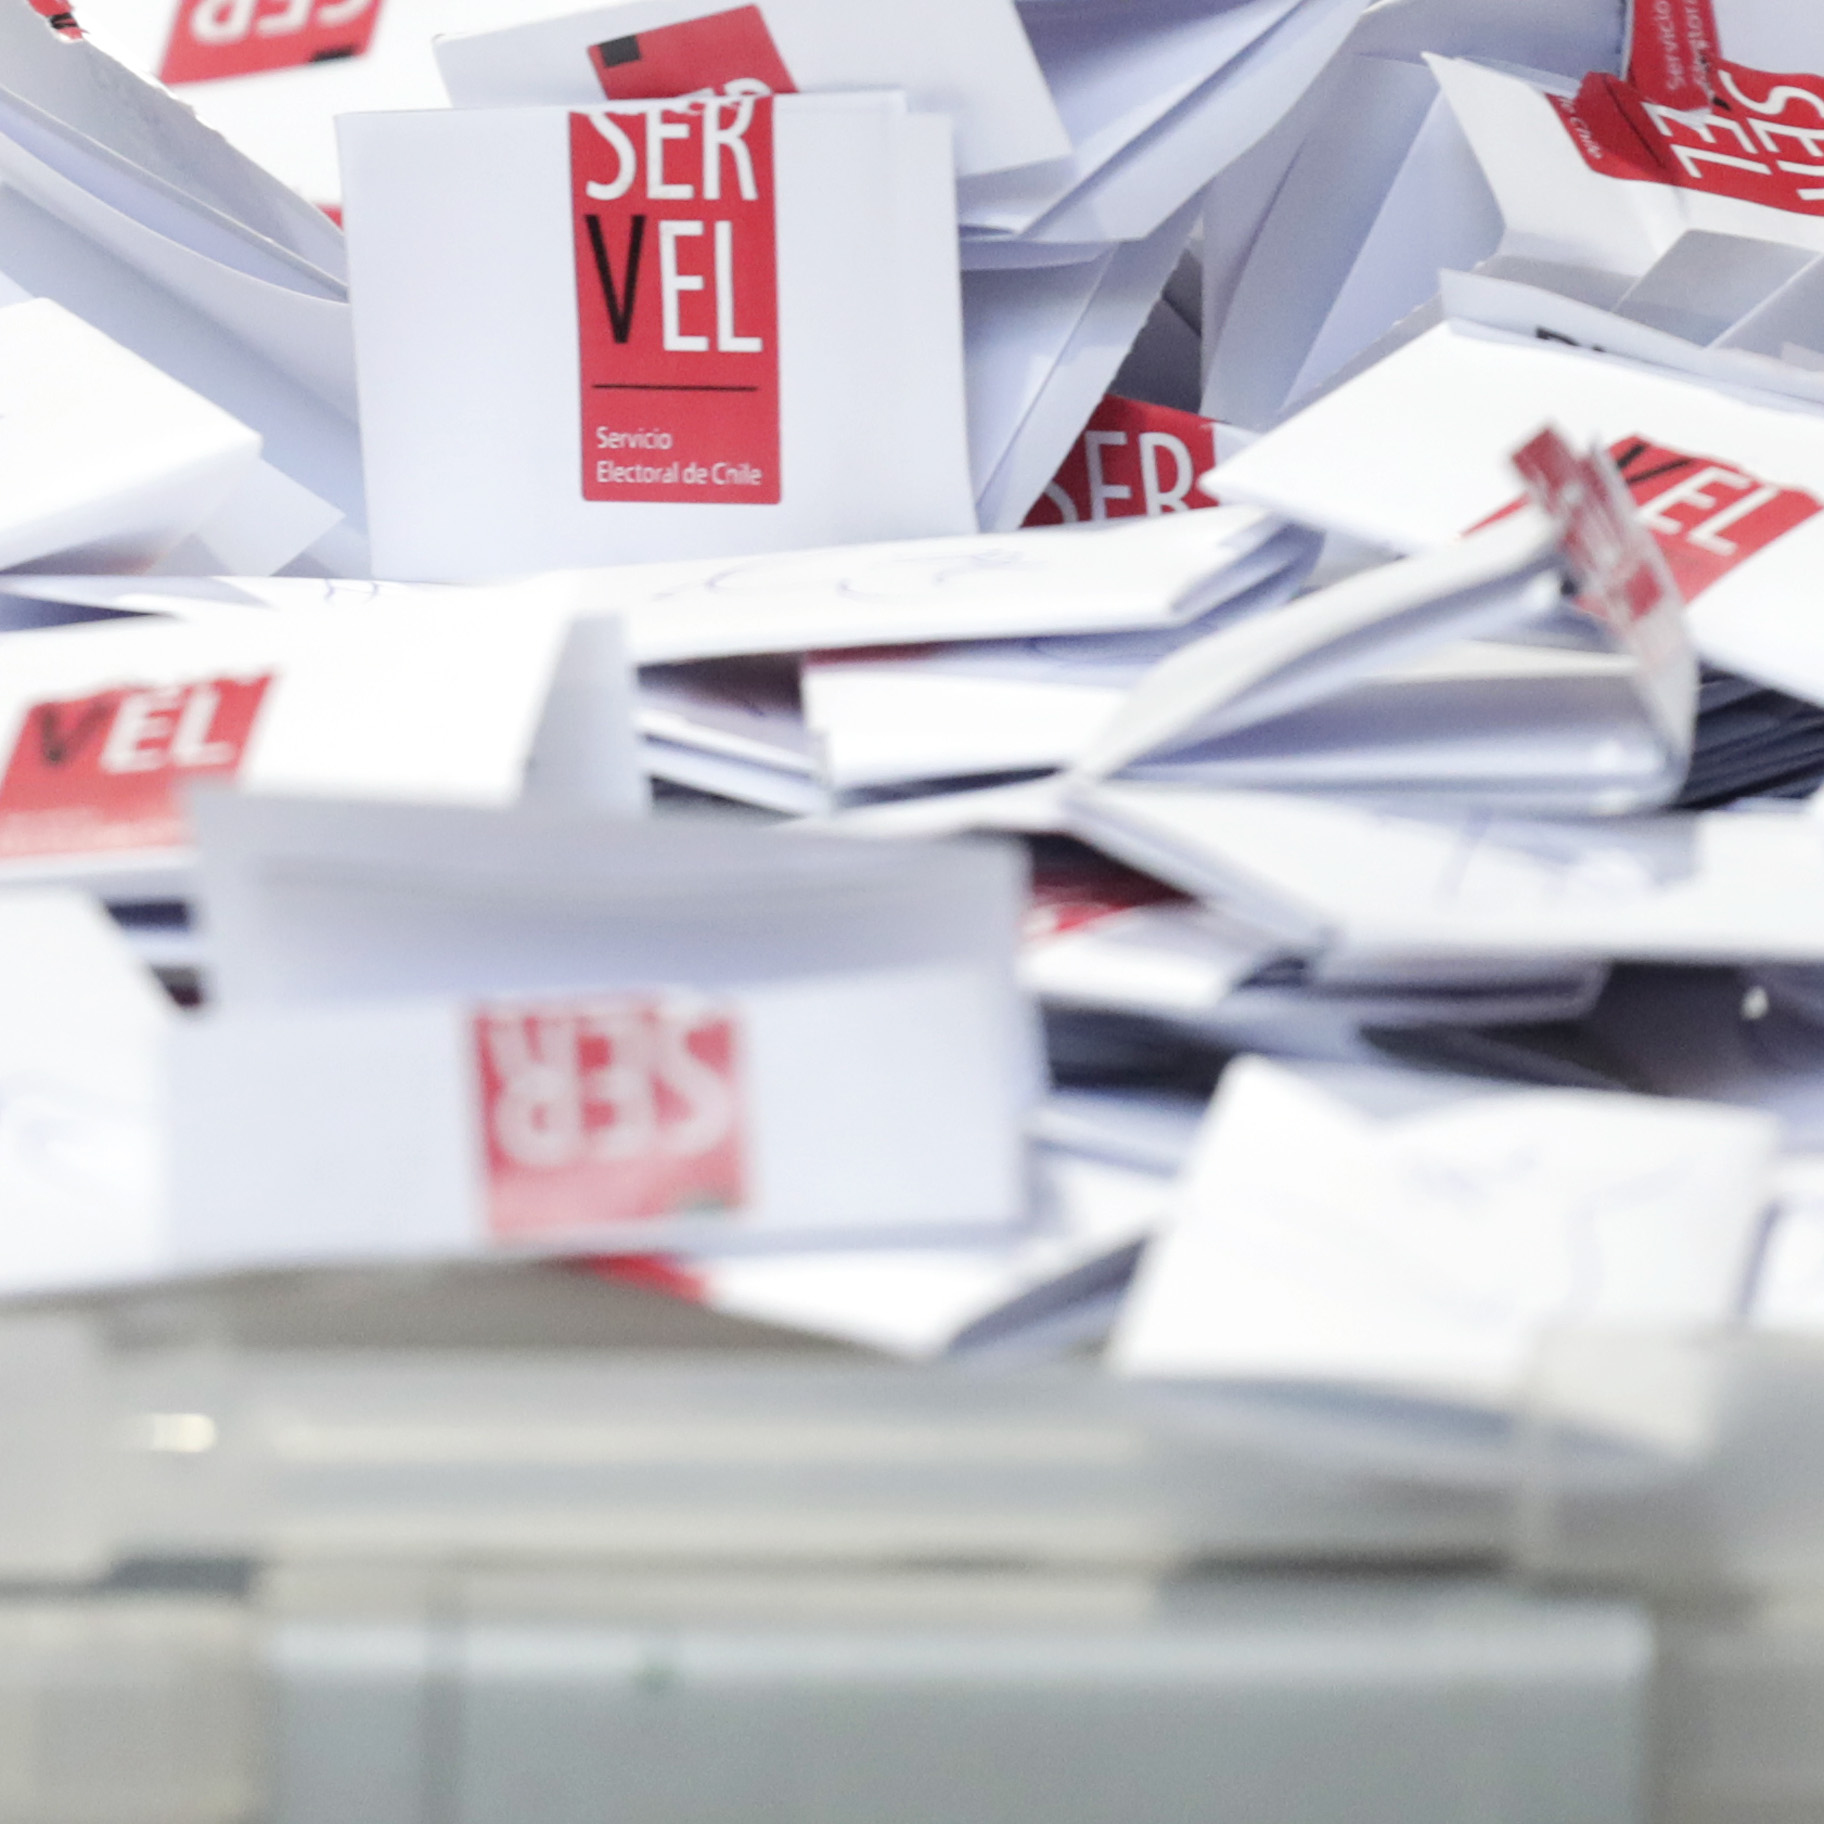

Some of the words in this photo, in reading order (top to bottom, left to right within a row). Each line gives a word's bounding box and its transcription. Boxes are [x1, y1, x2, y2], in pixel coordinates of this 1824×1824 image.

[585, 96, 759, 201] SER
[1640, 97, 1773, 179] EL
[584, 213, 763, 353] VEL
[596, 426, 673, 450] Servicio
[597, 460, 679, 484] Electoral
[683, 462, 708, 485] de
[712, 462, 762, 486] Chile
[38, 680, 236, 774] VEL
[488, 1002, 734, 1167] SER
